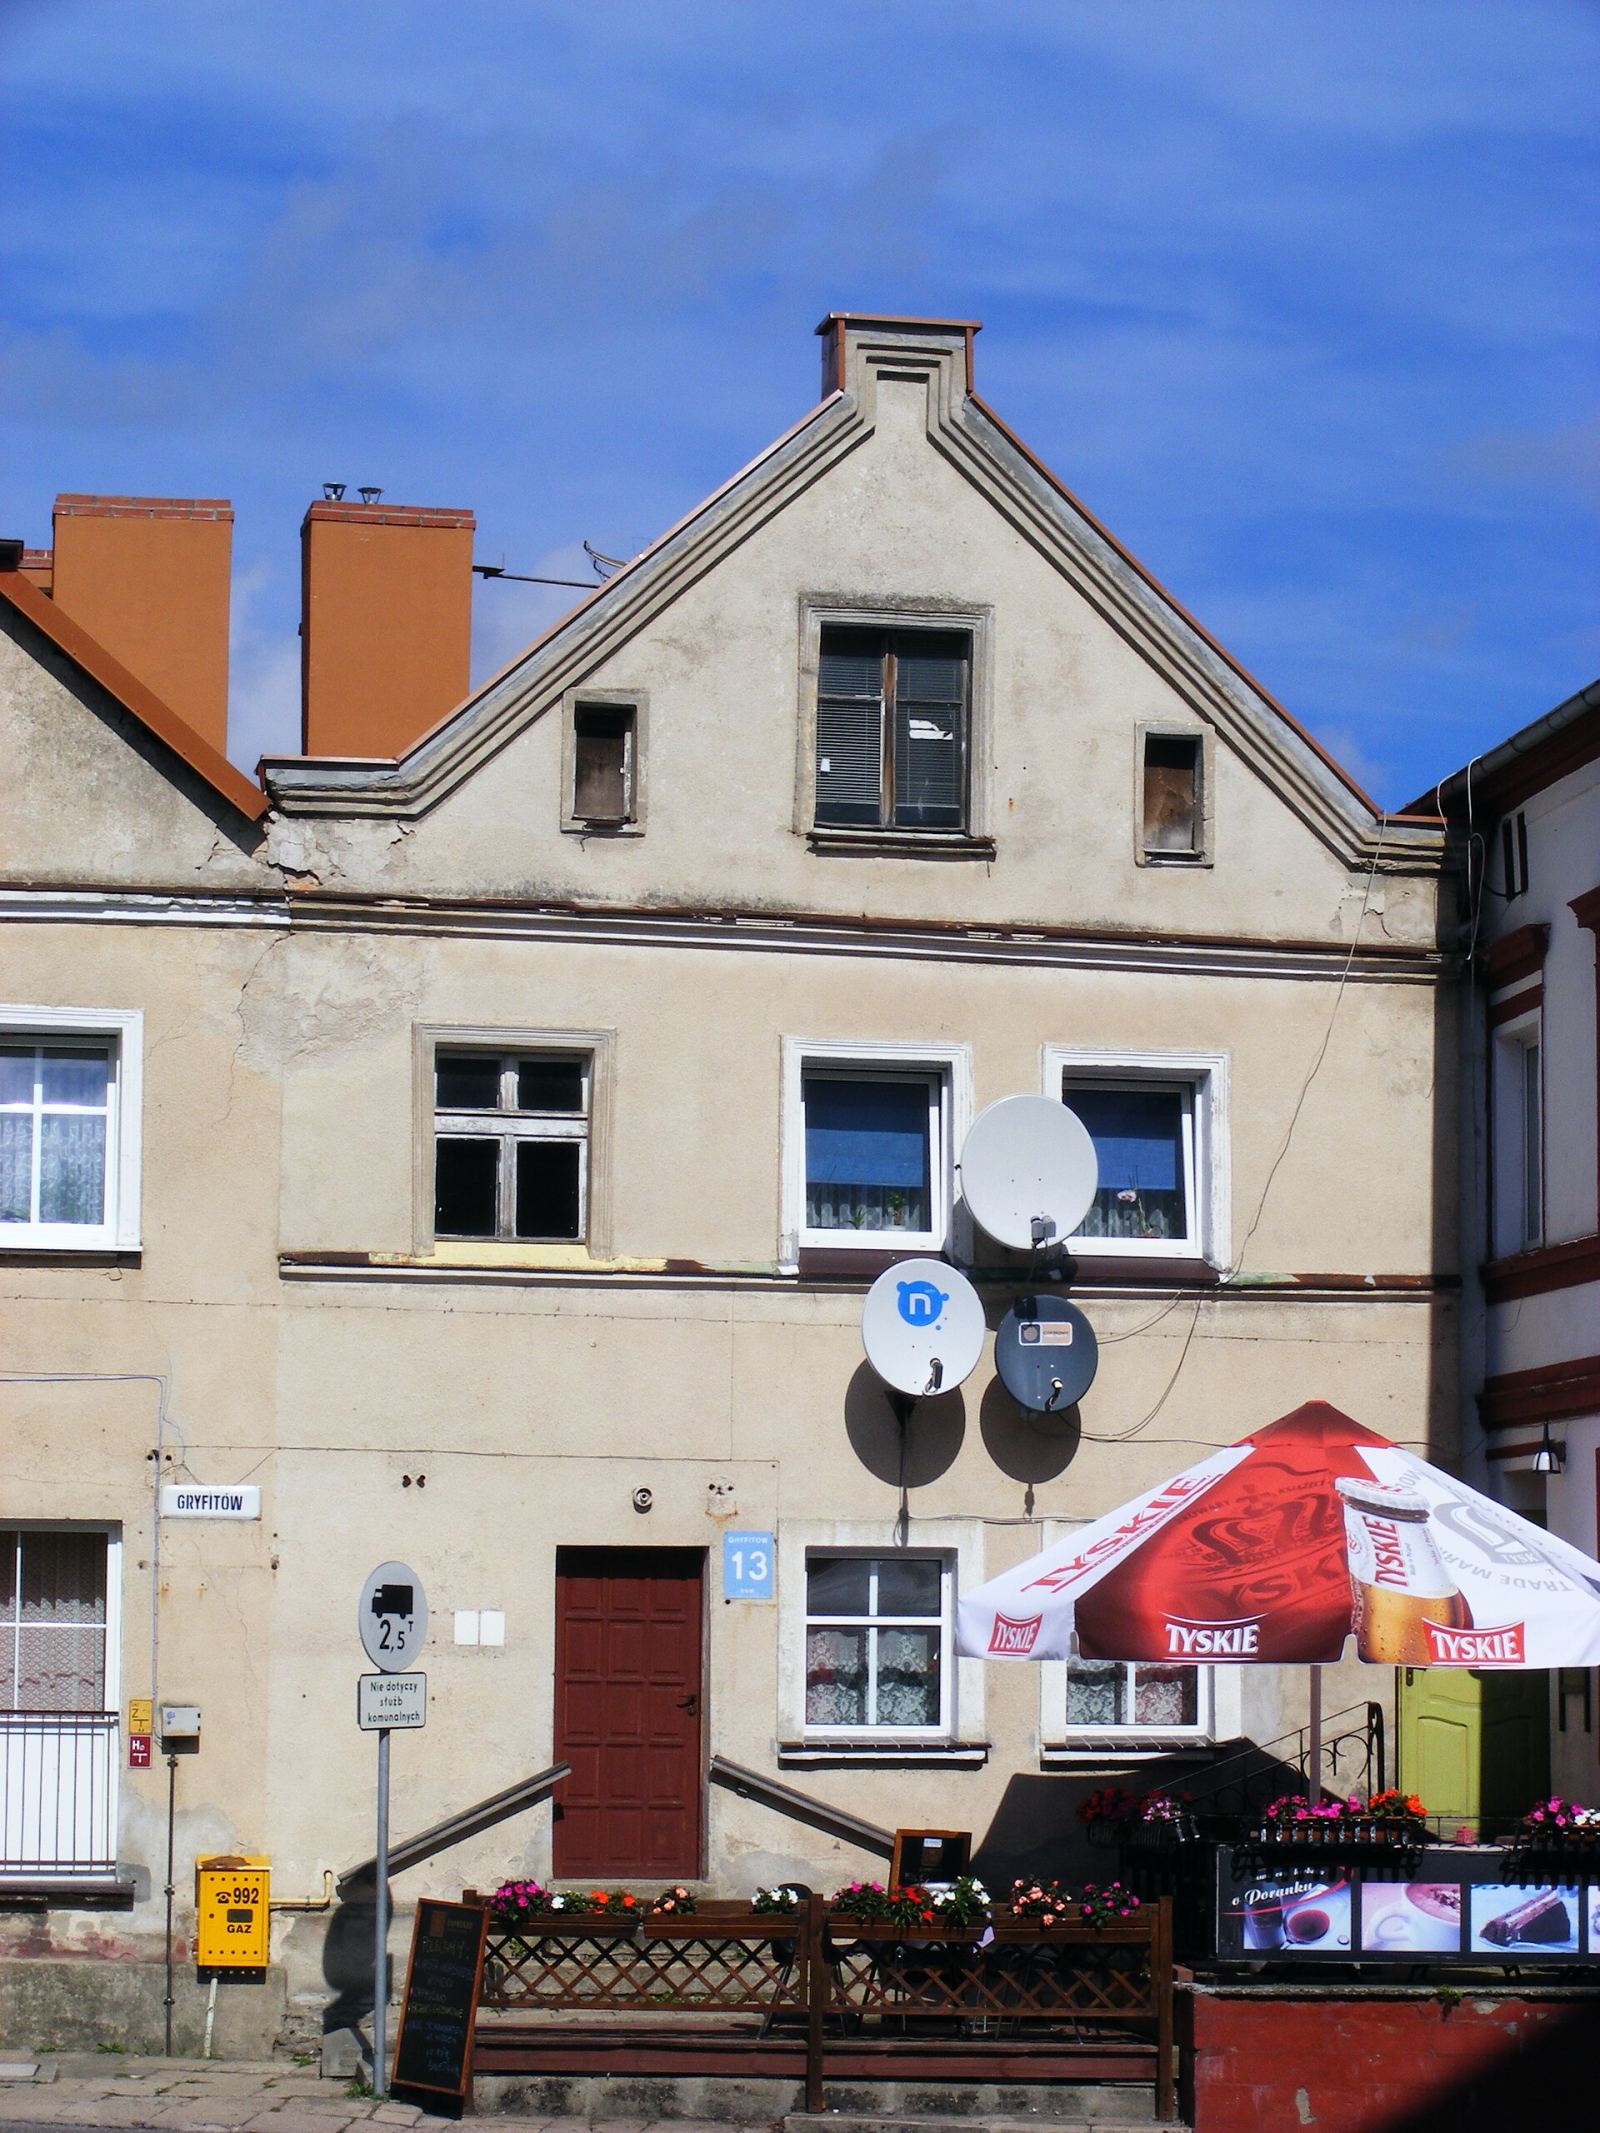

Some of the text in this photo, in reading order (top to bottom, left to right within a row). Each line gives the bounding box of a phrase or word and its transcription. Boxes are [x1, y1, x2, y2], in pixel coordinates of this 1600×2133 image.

[177, 1492, 243, 1510] GRYFITÓW
[1020, 1474, 1209, 1592] TYSKIE
[1362, 1515, 1408, 1586] TYSKIE
[732, 1551, 767, 1580] 13
[1500, 1574, 1573, 1592] TRADE
[994, 1621, 1037, 1648] TYSKIE
[1165, 1623, 1260, 1654] TYSKIE
[1431, 1630, 1520, 1660] TYSKIE
[370, 1682, 418, 1693] Nie dotyczy
[380, 1696, 403, 1706] służb
[368, 1711, 420, 1723] komunalnych
[233, 1887, 259, 1904] 992
[1244, 1881, 1313, 1905] Poranku
[227, 1924, 252, 1933] GAZ
